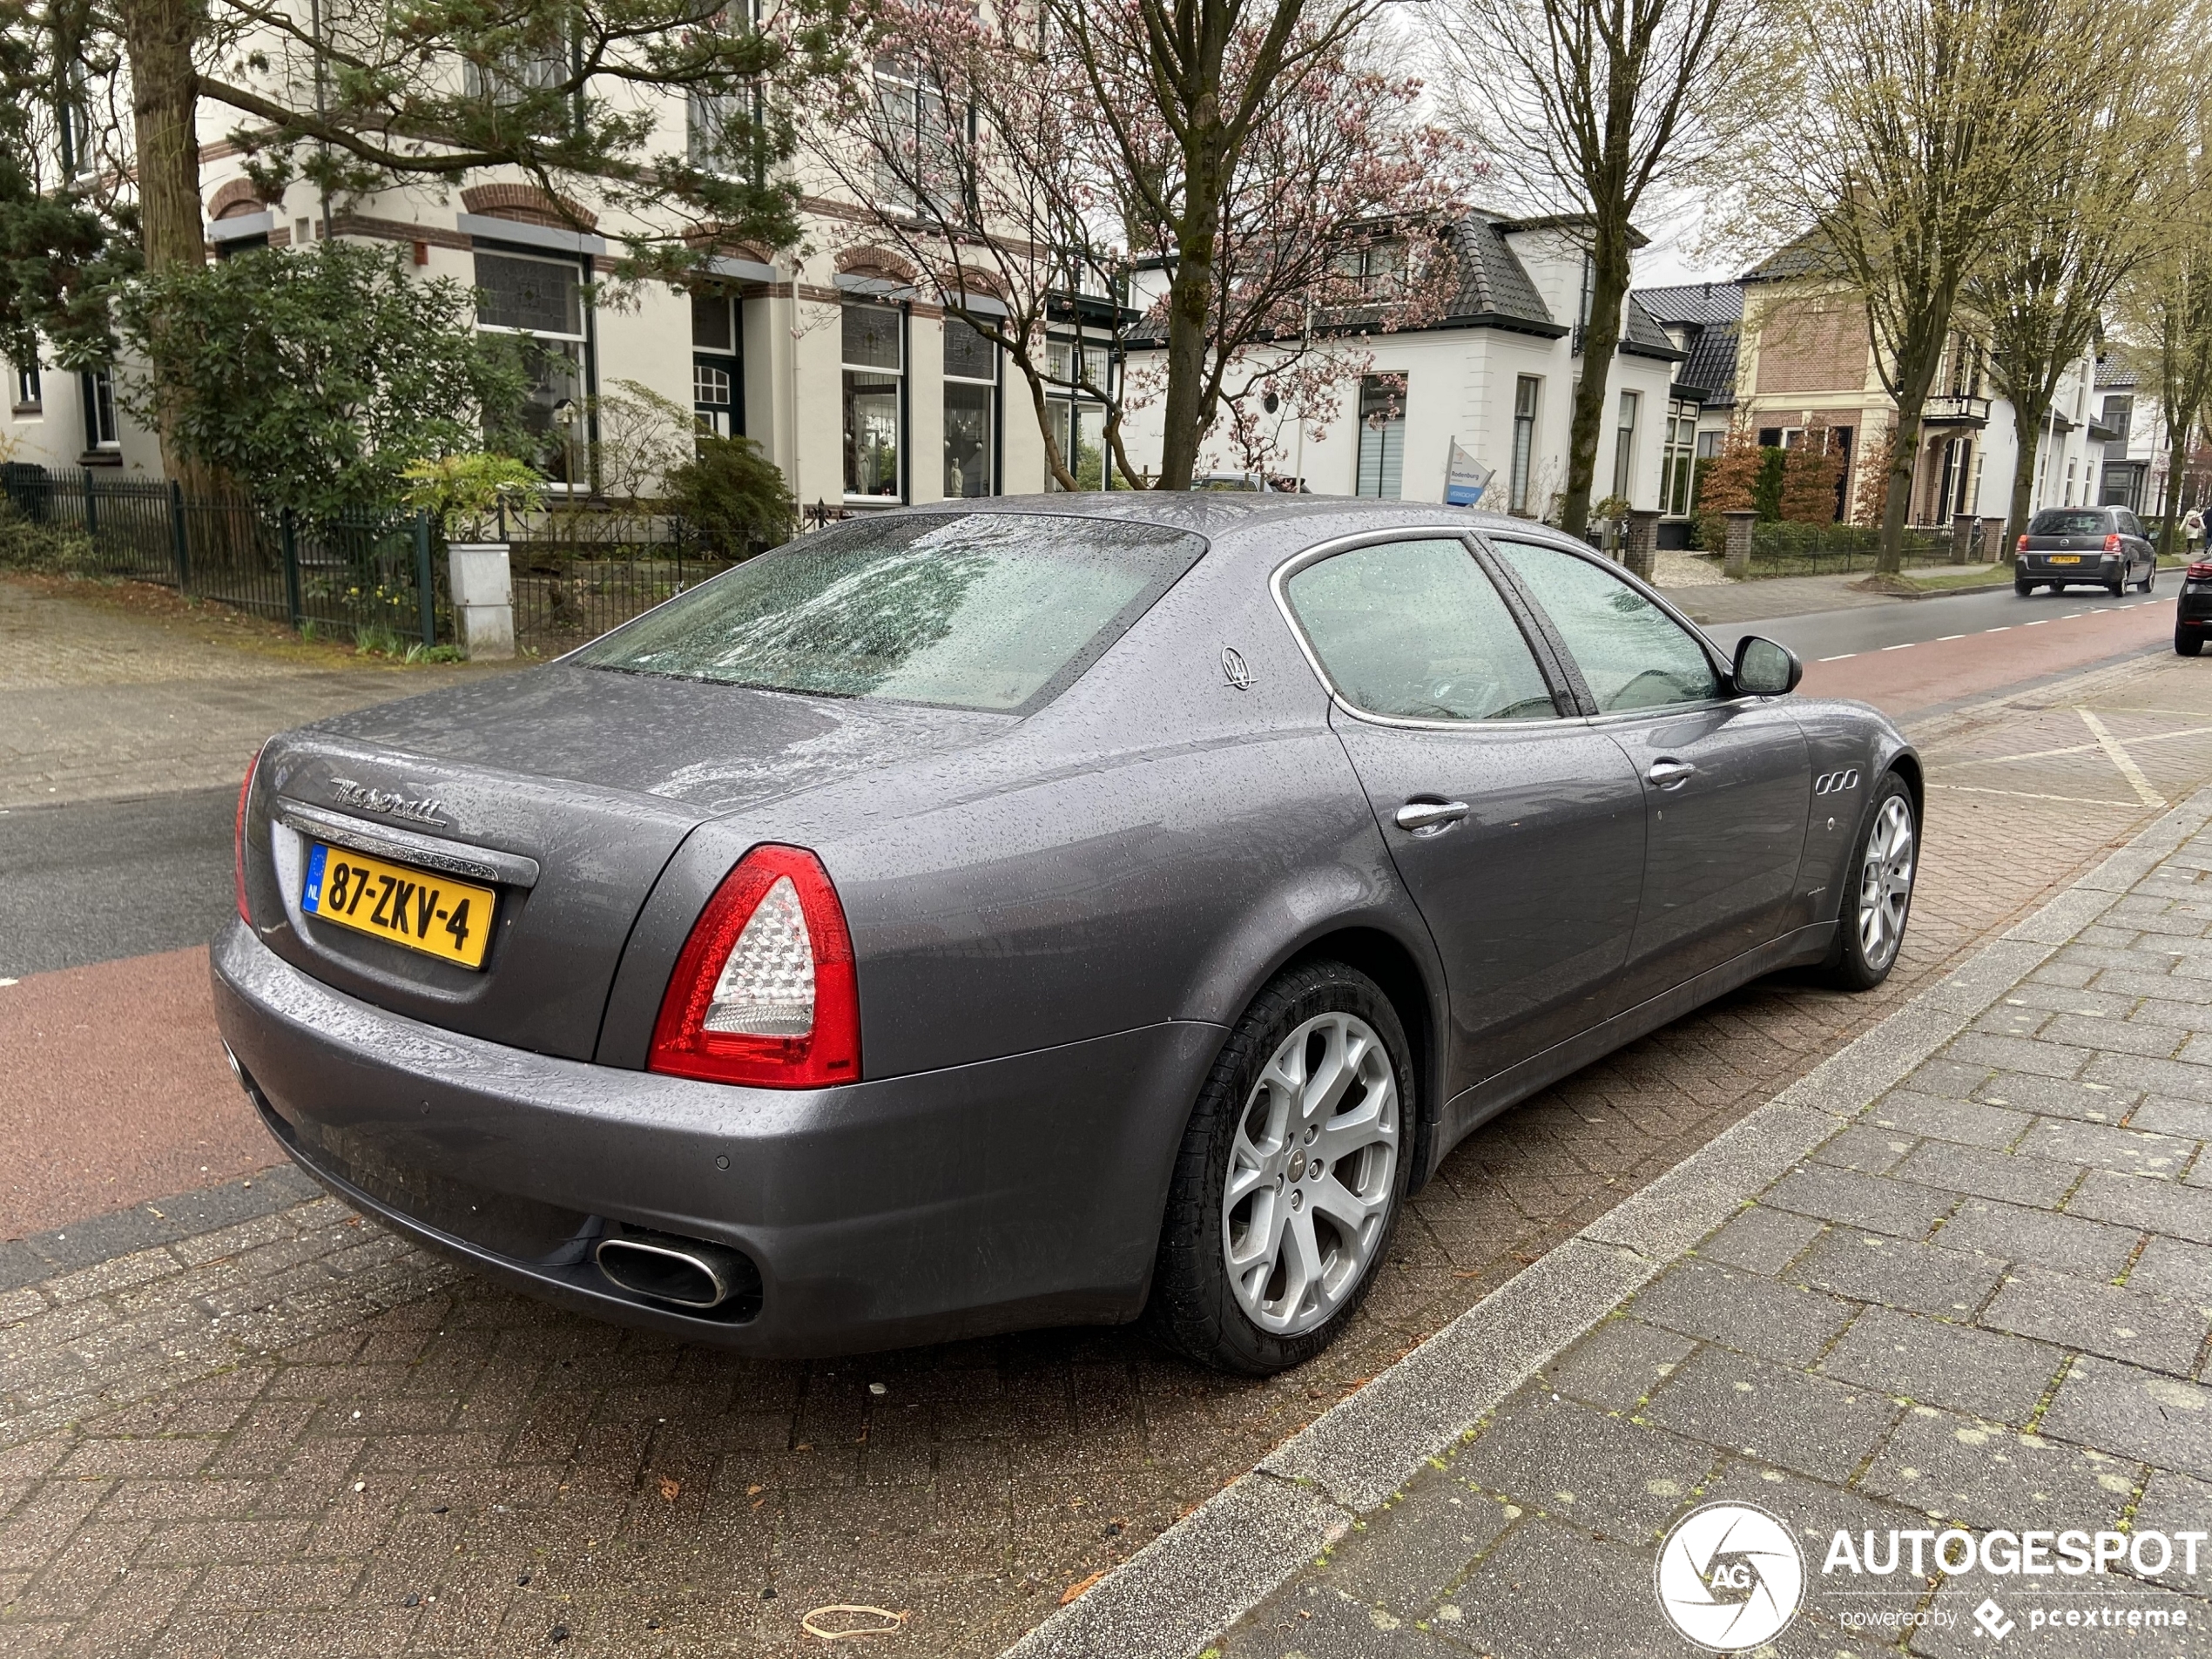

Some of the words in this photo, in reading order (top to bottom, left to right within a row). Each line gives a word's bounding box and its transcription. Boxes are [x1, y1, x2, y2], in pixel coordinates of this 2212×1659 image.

[1451, 471, 1480, 480] Rodenburg
[307, 884, 318, 900] NL
[328, 862, 470, 951] 87-ZKV-4
